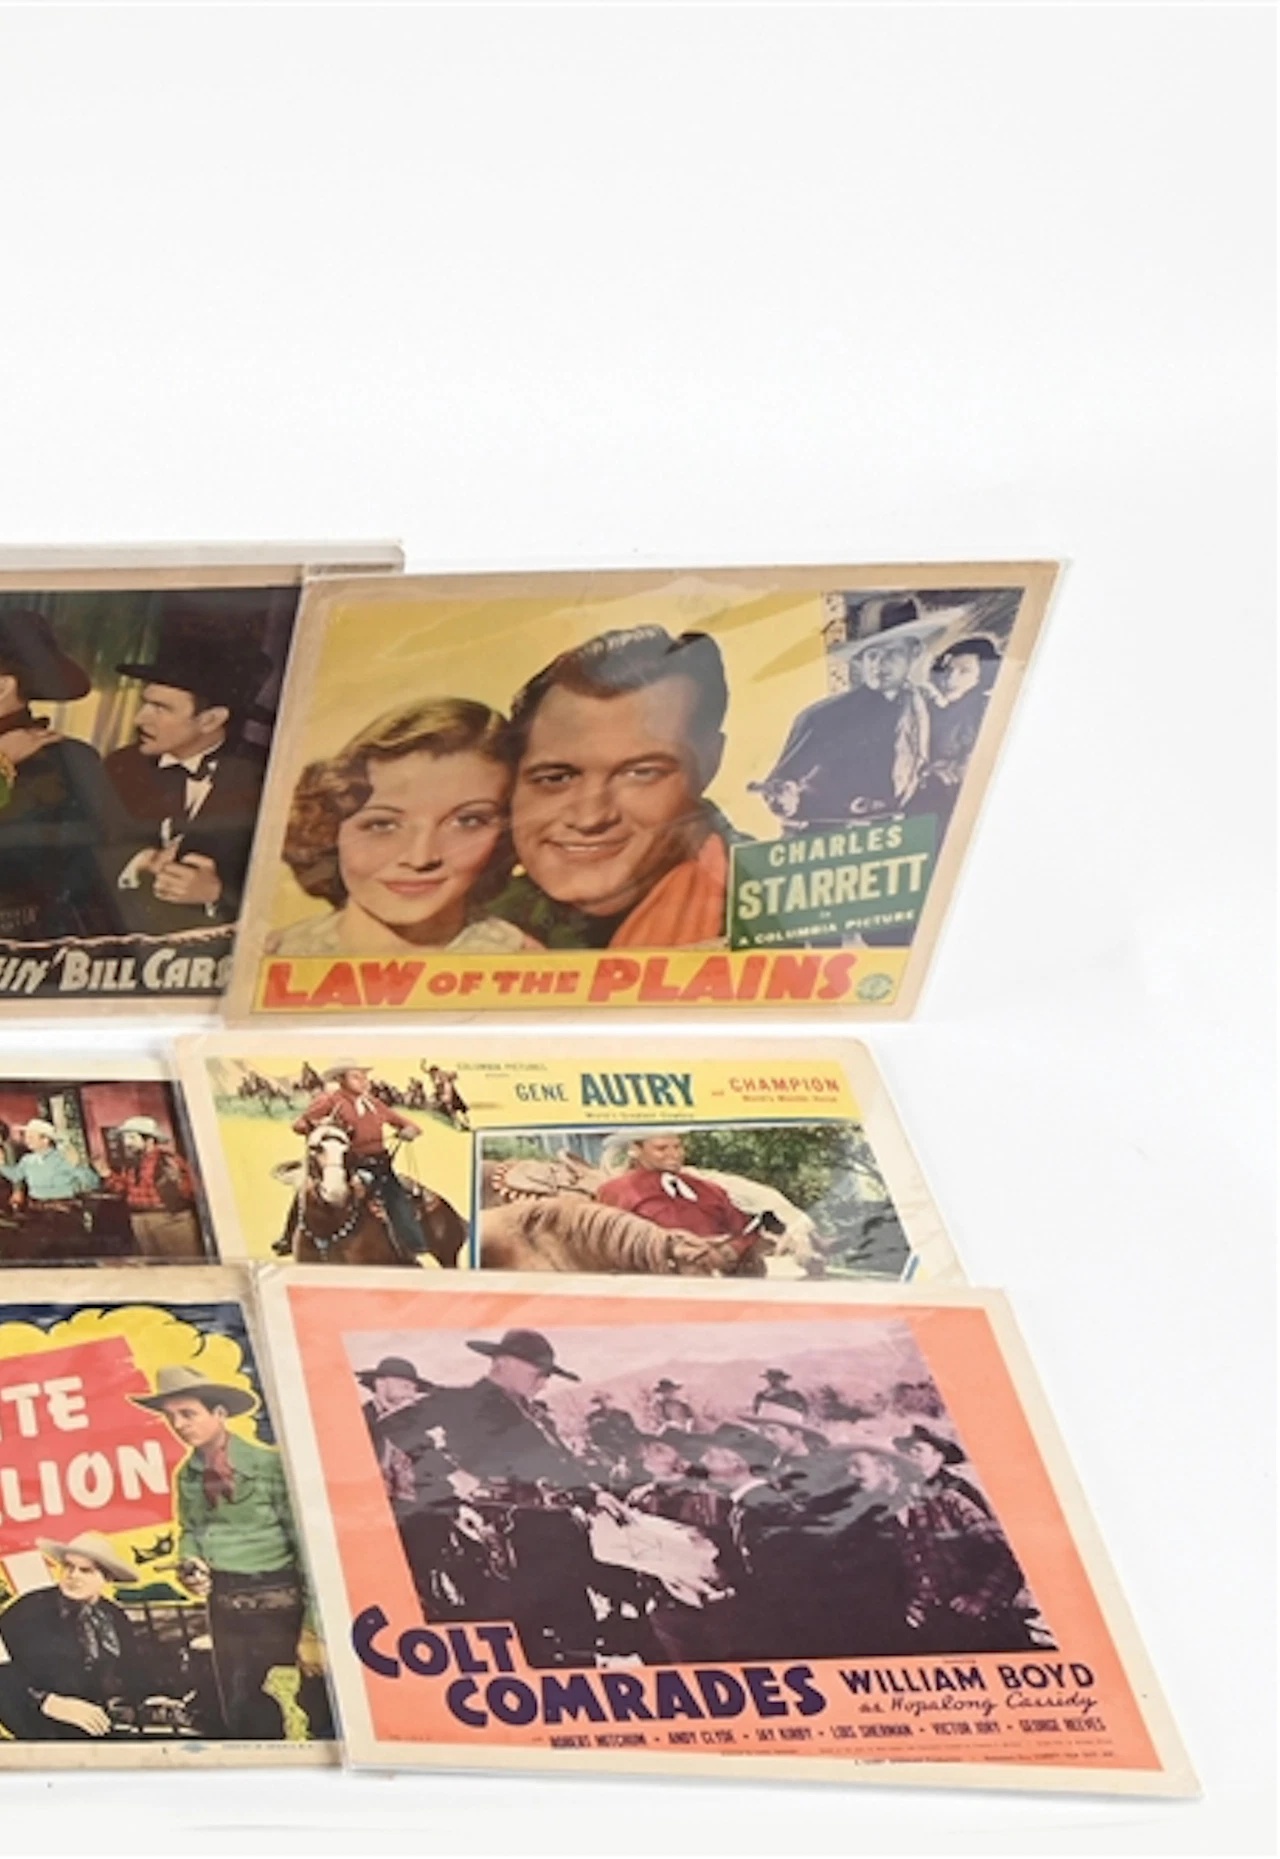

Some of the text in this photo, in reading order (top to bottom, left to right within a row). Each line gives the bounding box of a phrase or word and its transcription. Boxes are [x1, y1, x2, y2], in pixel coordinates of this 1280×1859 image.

[769, 825, 903, 867] CHARLES
[738, 853, 929, 920] STARRETT
[755, 923, 838, 944] COLUMBIA
[845, 910, 915, 930] PICTURE
[59, 950, 137, 991] BILL
[262, 952, 858, 1009] LAW OF THE PLAINS
[515, 1072, 840, 1107] GENE AUTRY CHAMPION
[352, 1605, 517, 1679] COLT
[445, 1665, 828, 1729] COMRADES
[839, 1662, 1096, 1695] WILLIAM BOYD
[859, 1691, 1099, 1718] as Hopalong Cassidy
[550, 1734, 589, 1749] ROBERT
[595, 1732, 647, 1747] MITCHUM
[668, 1731, 698, 1744] ANDY
[700, 1730, 736, 1744] CLYDE
[780, 1728, 812, 1741] KIRBY
[931, 1723, 972, 1736] VICTOR
[1018, 1719, 1061, 1733] GEORGE
[1064, 1718, 1107, 1733] REEVES
